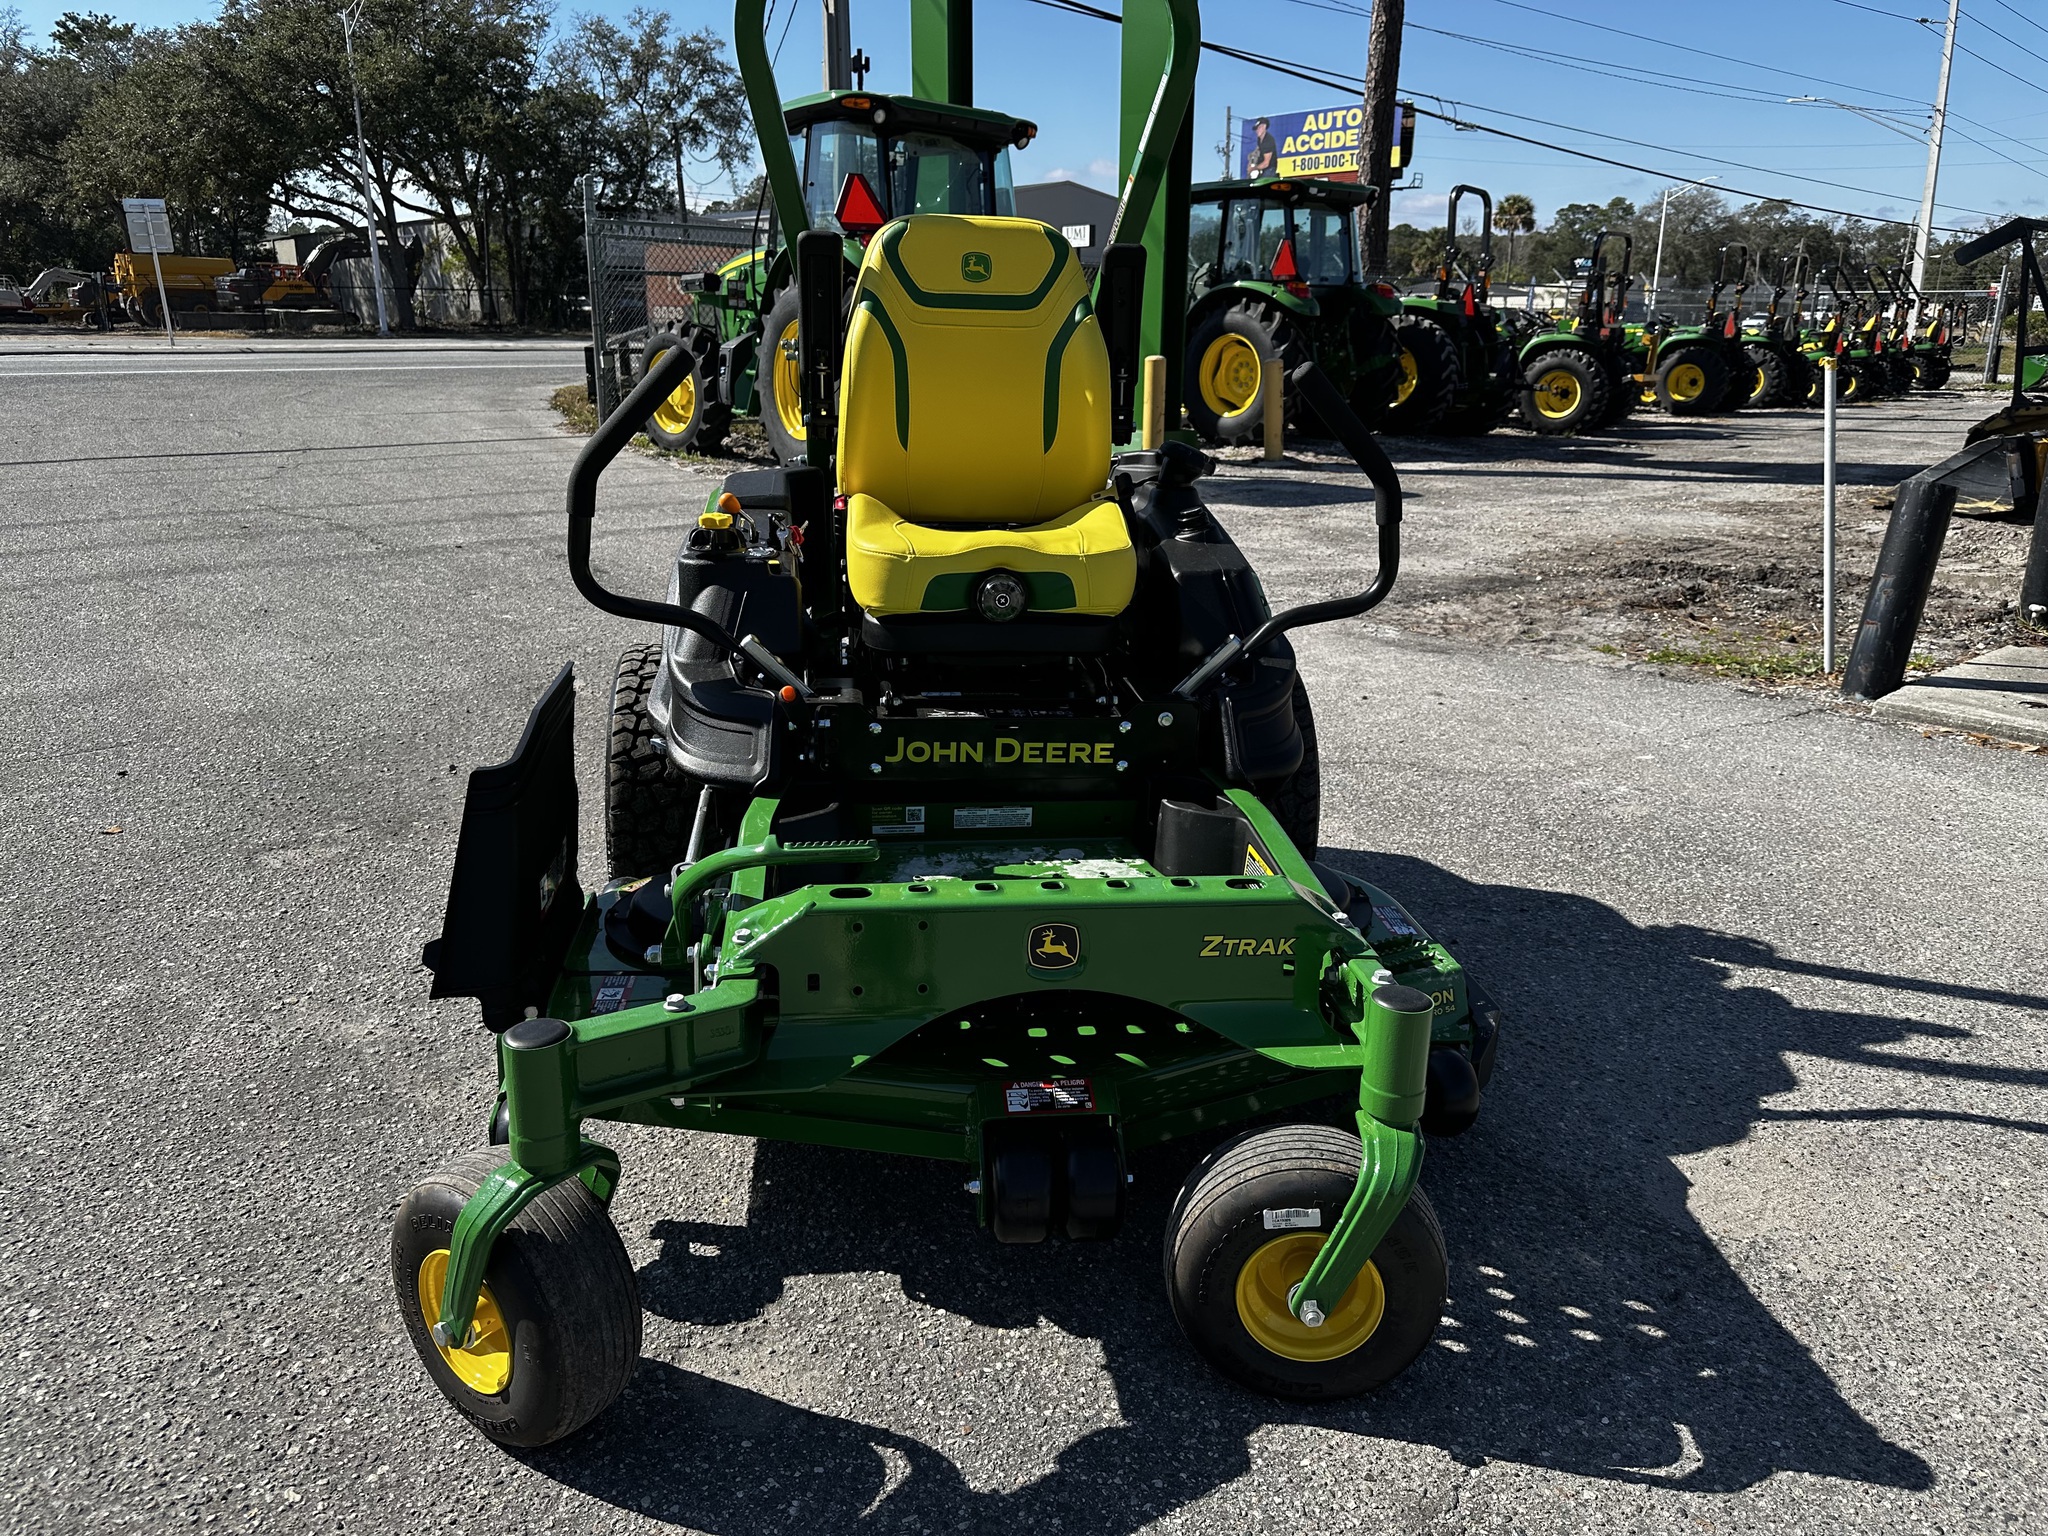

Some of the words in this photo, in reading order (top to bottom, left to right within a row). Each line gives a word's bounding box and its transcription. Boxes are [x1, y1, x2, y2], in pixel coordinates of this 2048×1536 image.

[1303, 108, 1362, 132] AUTO
[1281, 128, 1360, 154] ACCIDE
[885, 737, 983, 763] JOHN
[995, 737, 1115, 763] DEERE
[1199, 935, 1297, 956] ZTRAK
[1445, 1004, 1456, 1013] 54
[411, 1214, 453, 1233] RELIA
